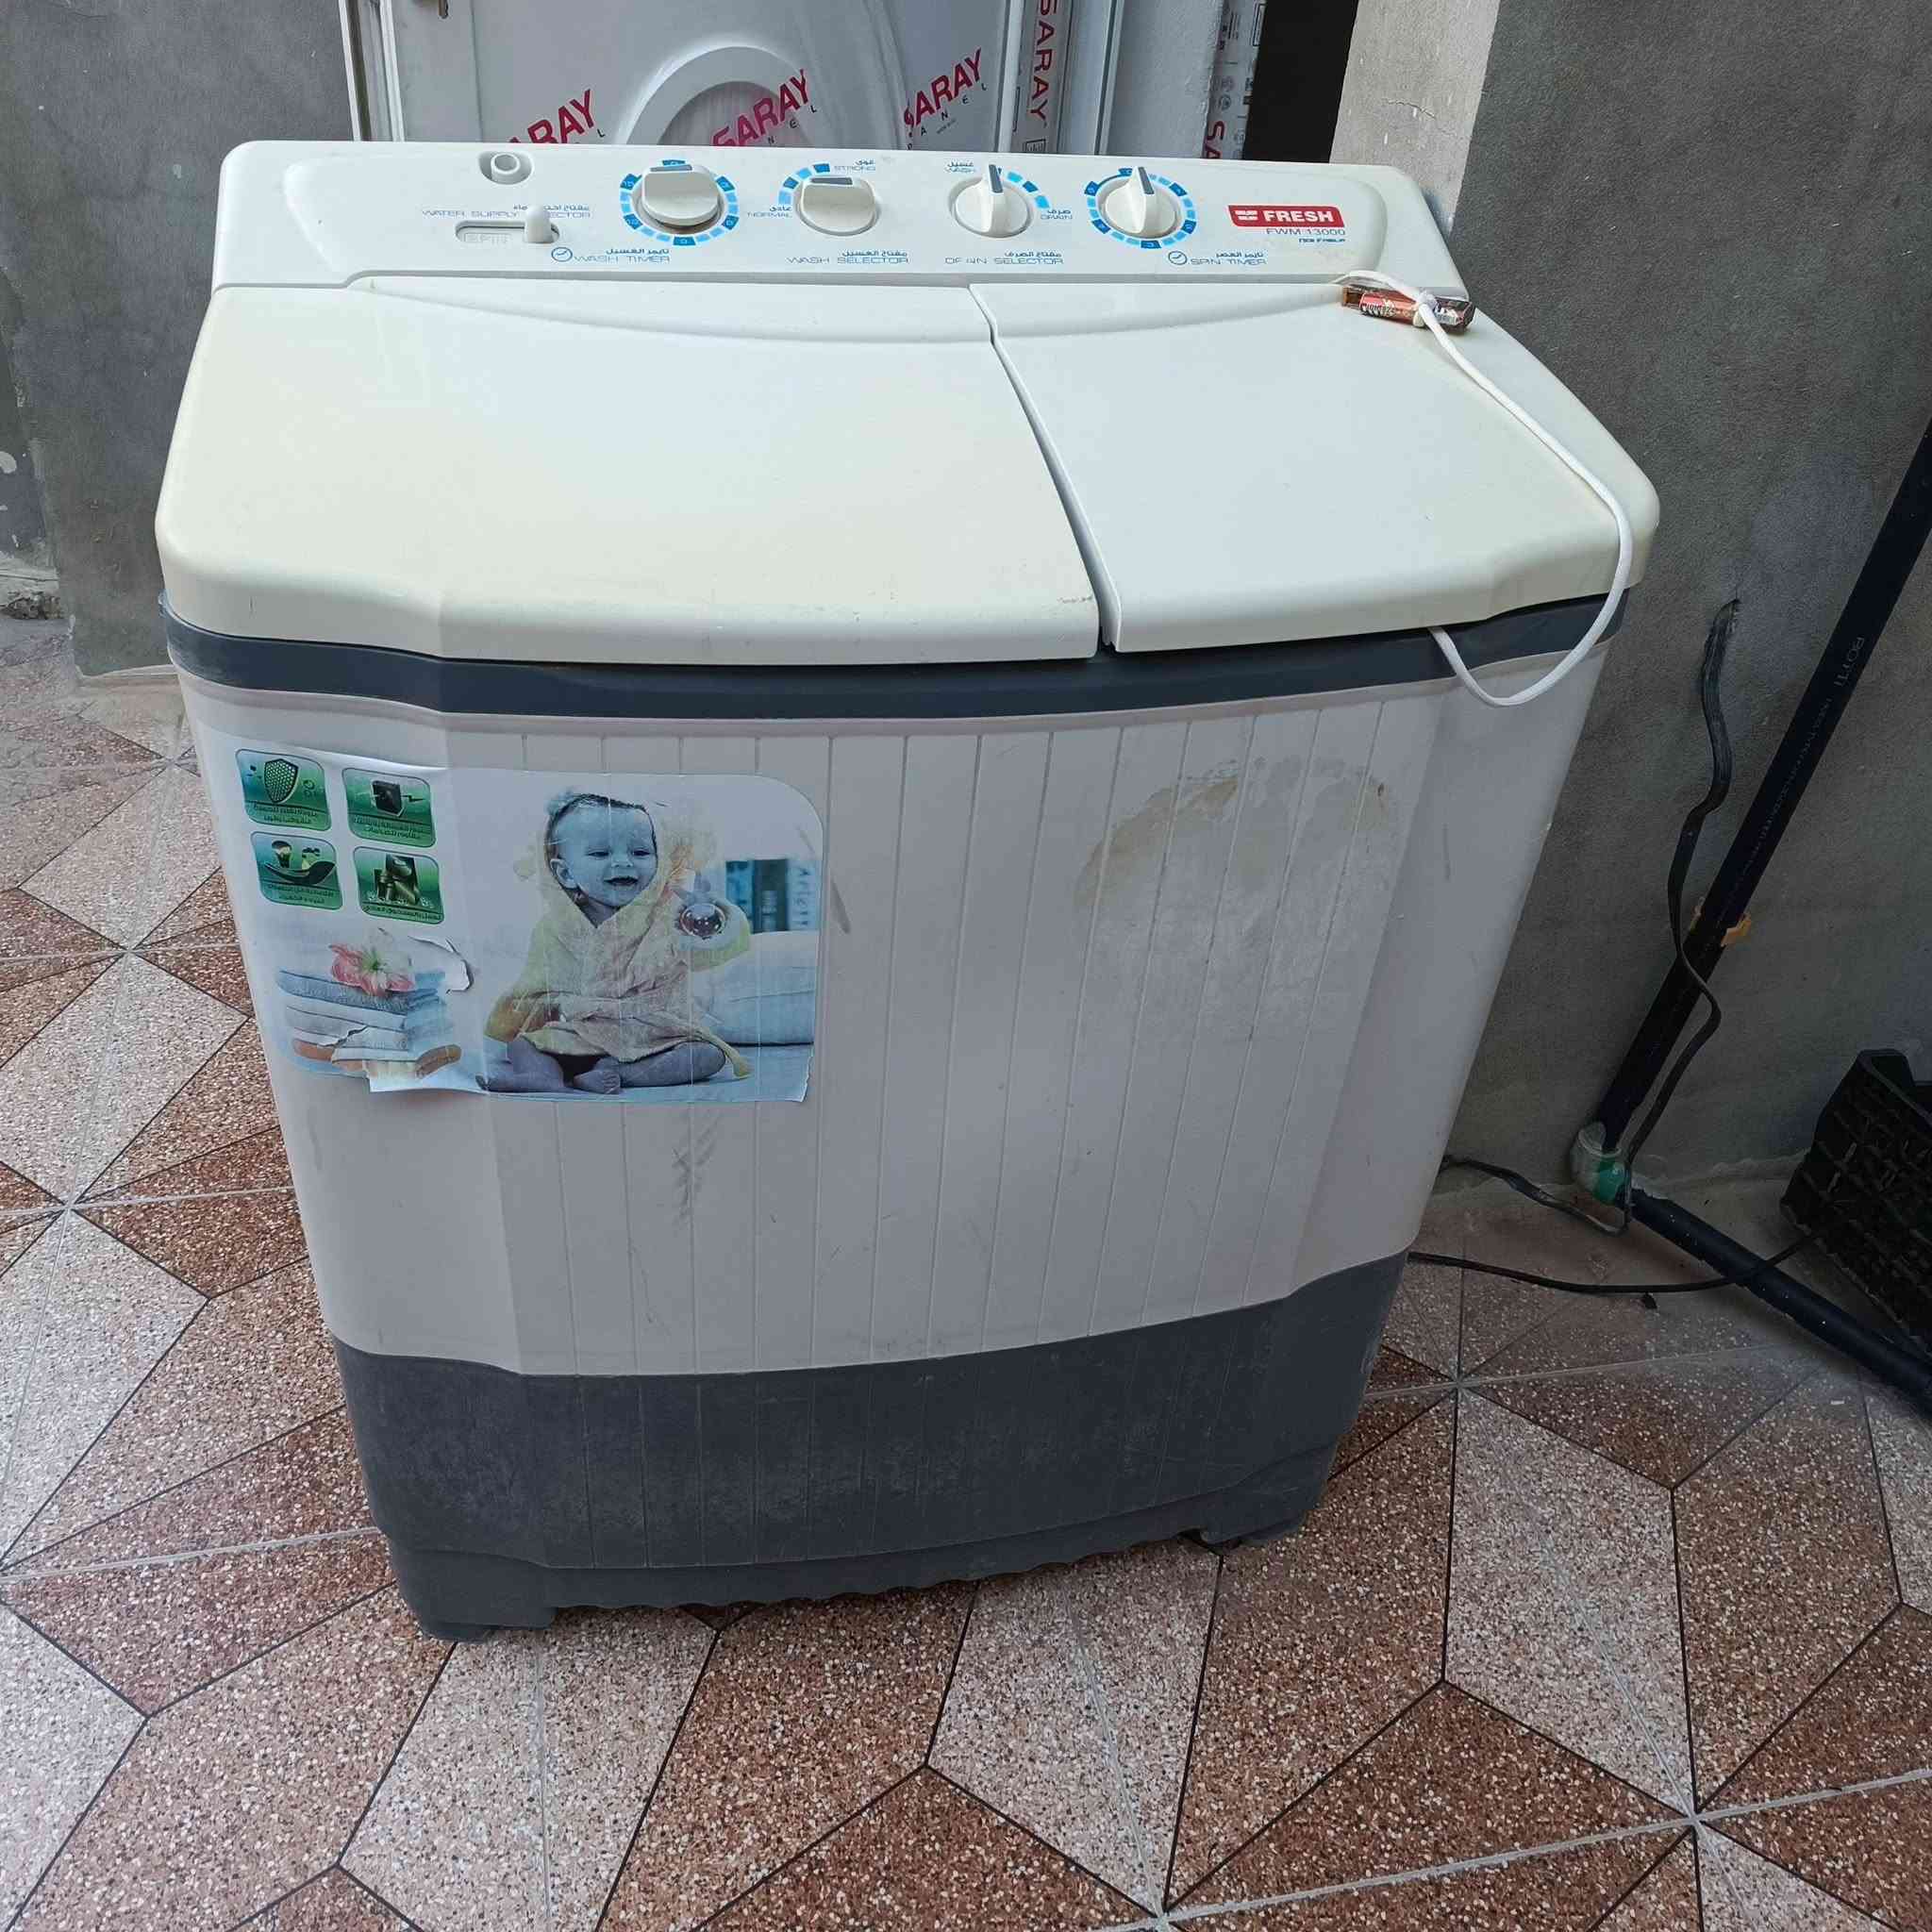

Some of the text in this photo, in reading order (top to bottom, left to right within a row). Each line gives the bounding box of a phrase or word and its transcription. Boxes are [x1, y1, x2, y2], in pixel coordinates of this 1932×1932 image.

[510, 90, 595, 143] RAY
[471, 210, 518, 219] SUPPLY
[1263, 210, 1336, 224] FRESH
